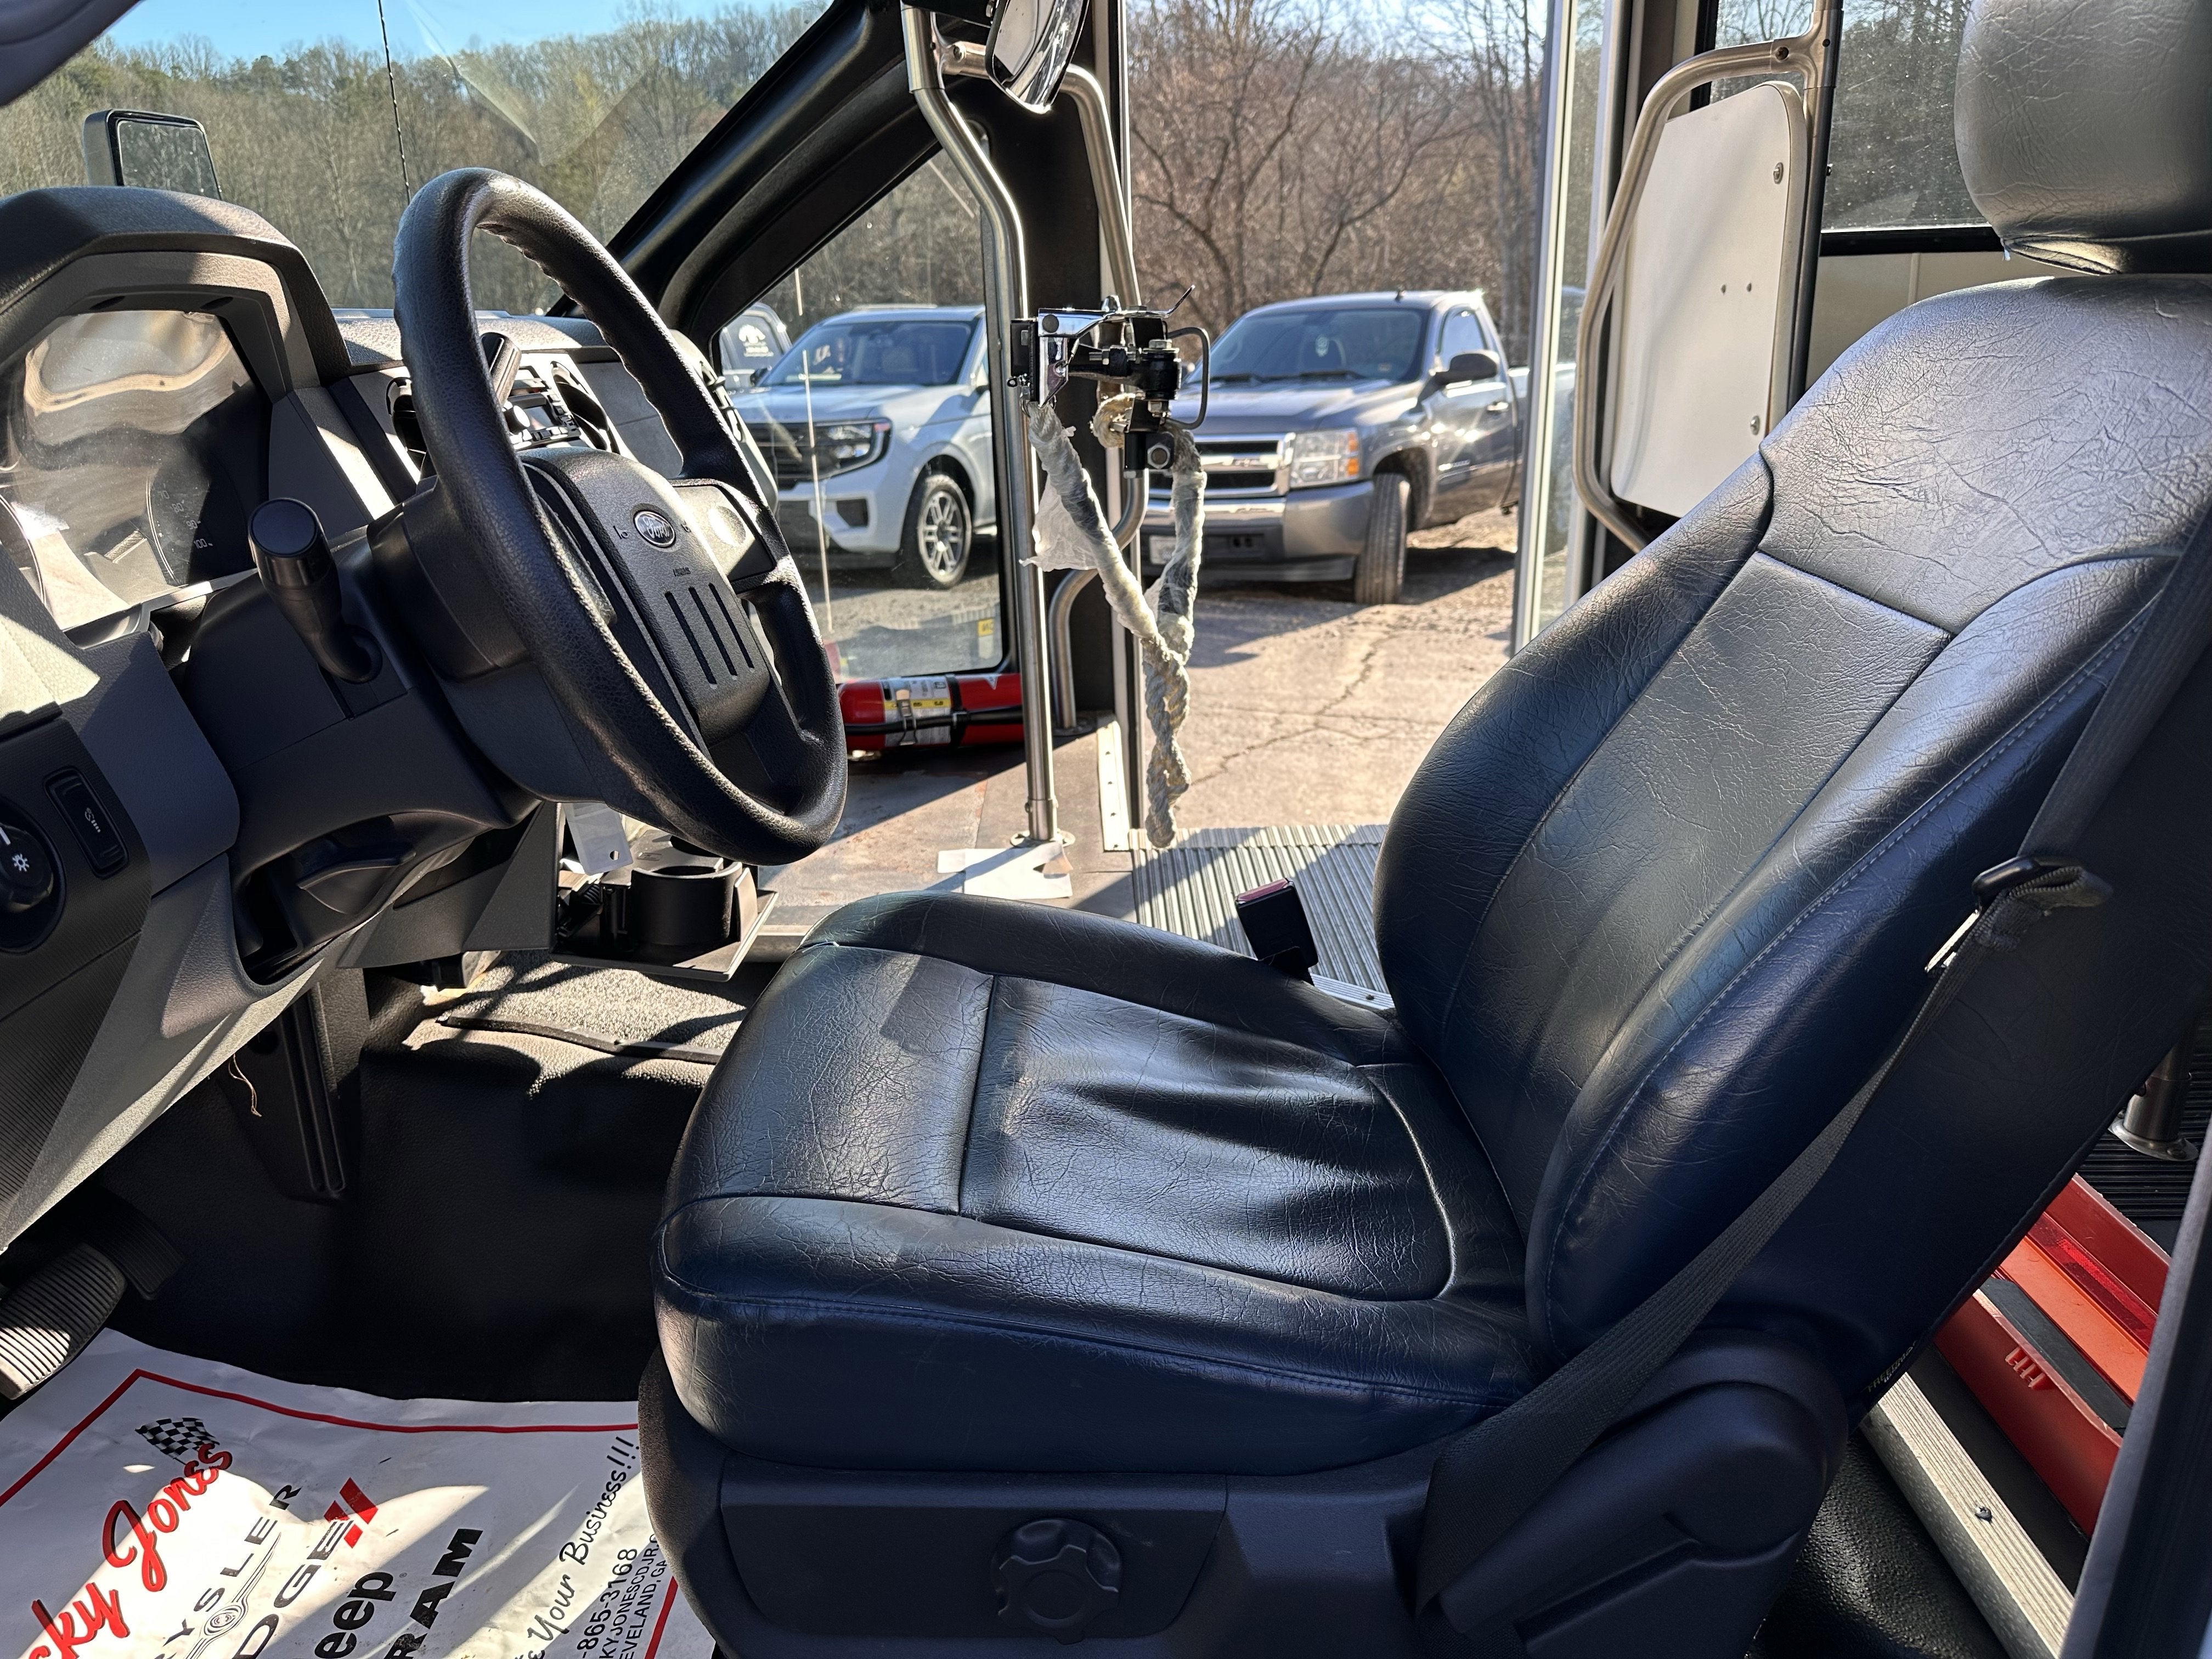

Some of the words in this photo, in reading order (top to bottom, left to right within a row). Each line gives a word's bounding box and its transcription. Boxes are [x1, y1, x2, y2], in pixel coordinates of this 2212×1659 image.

[194, 538, 207, 549] 100
[102, 1443, 233, 1592] Jones
[154, 1485, 302, 1659] YSLER
[527, 1573, 575, 1641] Your
[559, 1436, 640, 1565] Business!!!
[384, 1528, 483, 1659] RAM
[577, 1549, 637, 1658] -865-3168
